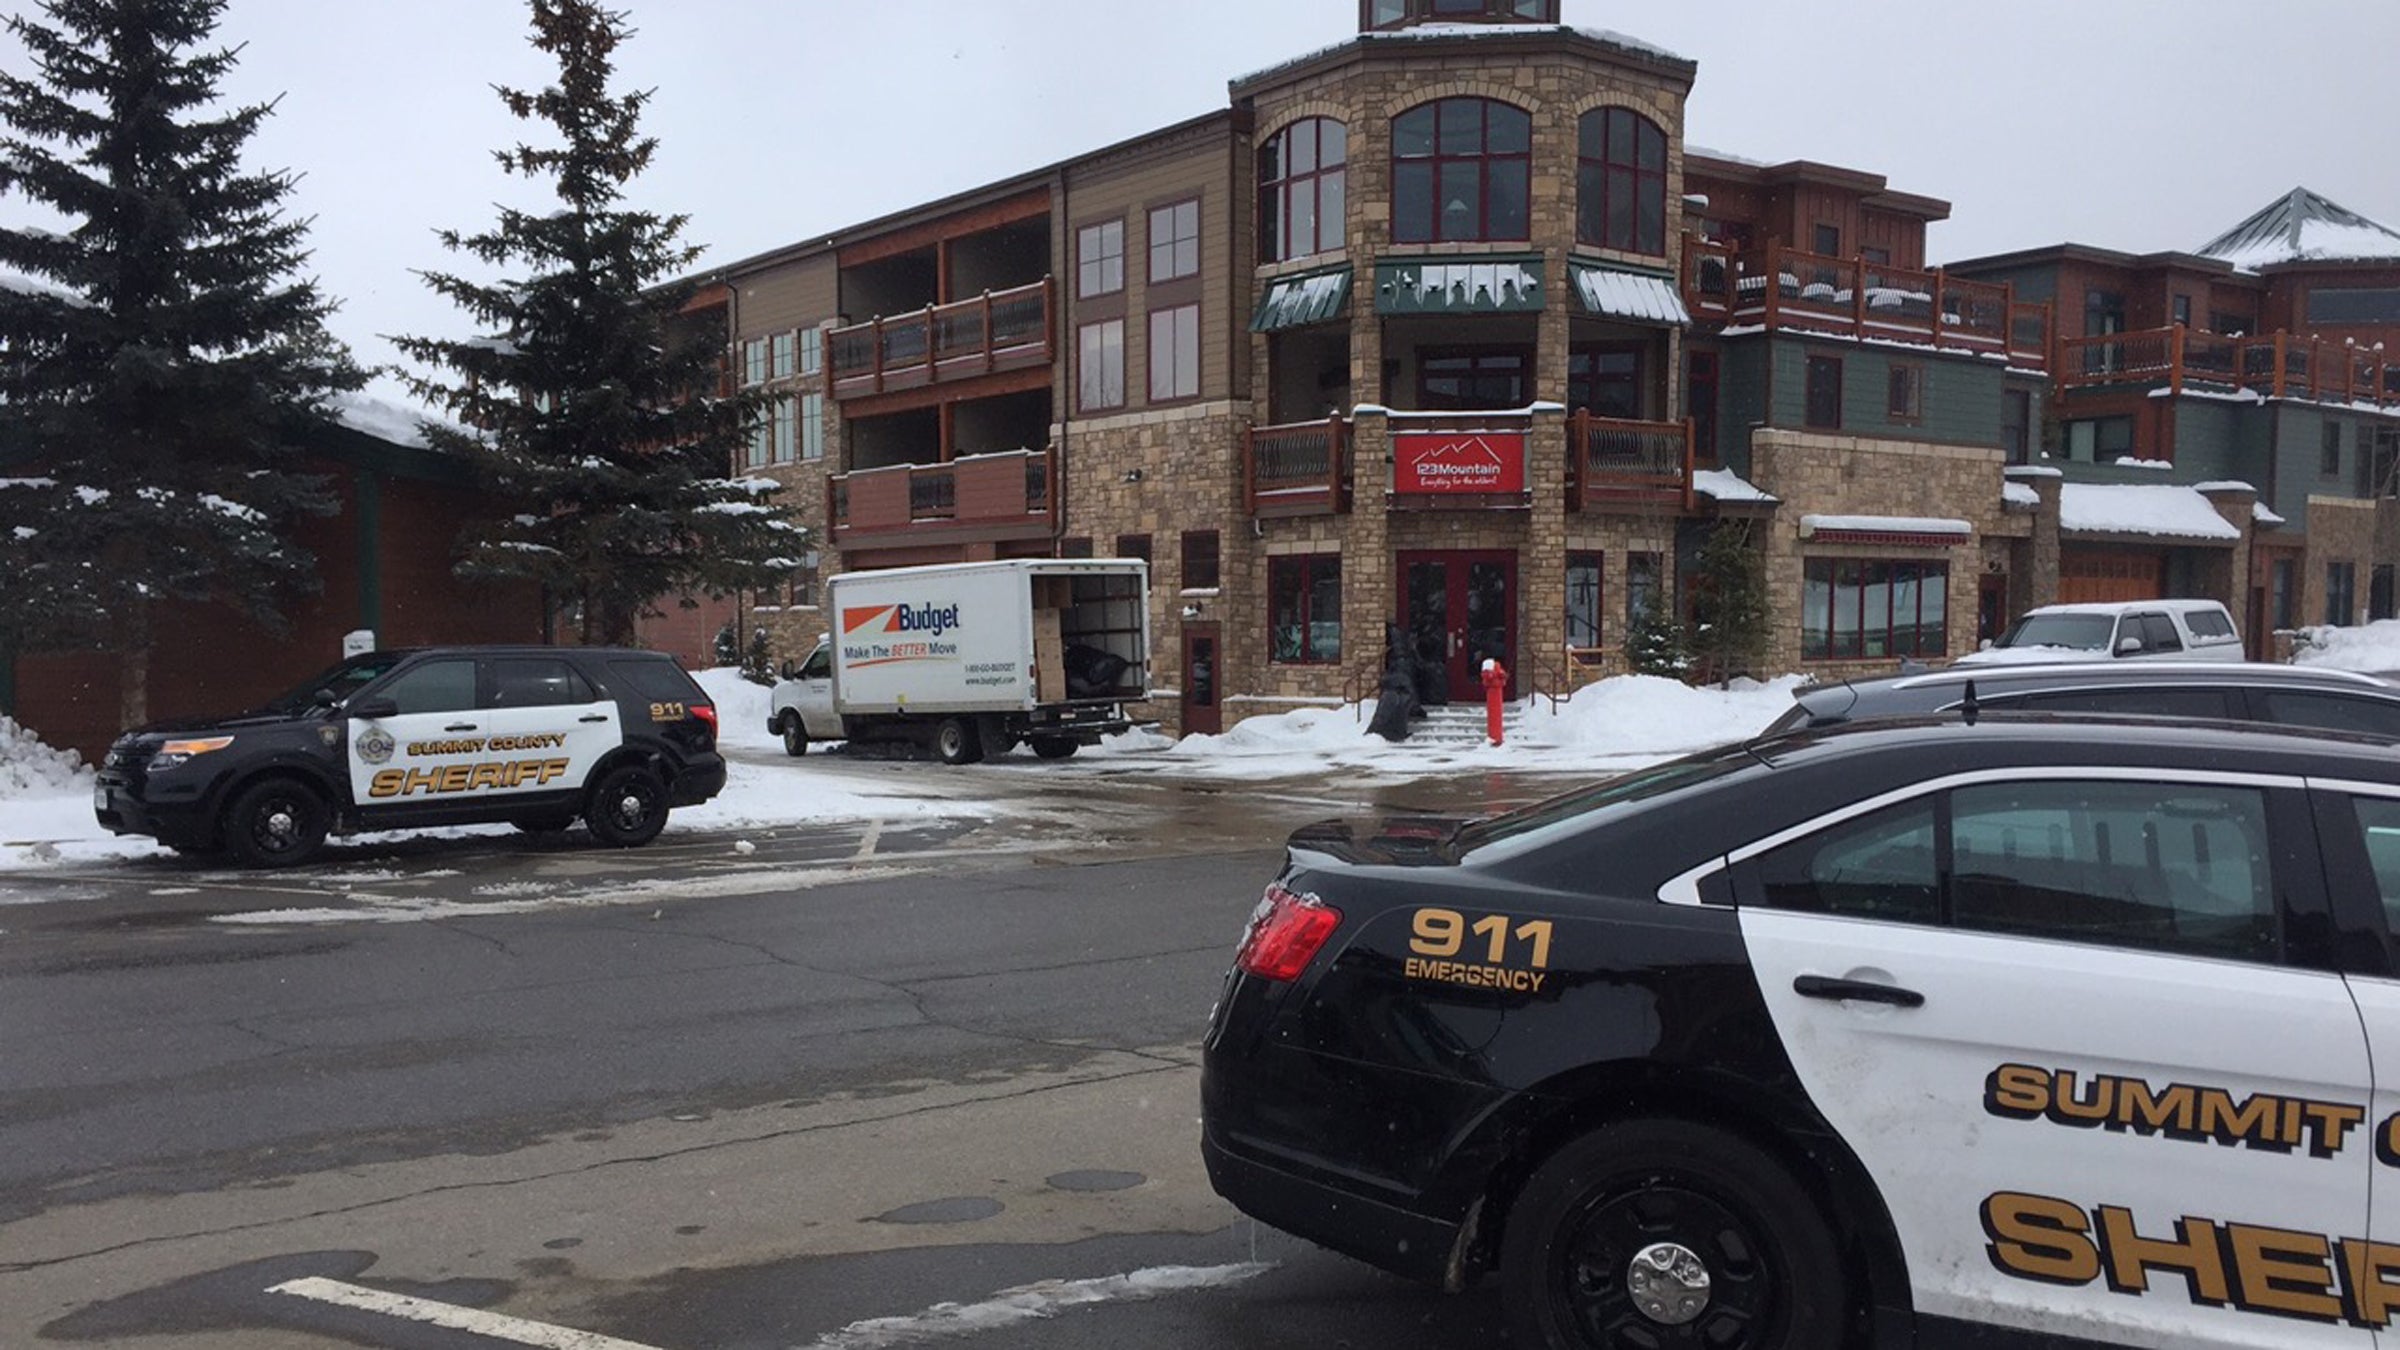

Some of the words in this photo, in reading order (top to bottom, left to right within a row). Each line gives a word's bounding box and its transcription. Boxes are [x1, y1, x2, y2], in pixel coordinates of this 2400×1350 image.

[899, 601, 959, 636] Budget
[844, 646, 870, 659] Make
[872, 644, 889, 657] The
[891, 643, 927, 656] BETTER
[929, 642, 957, 654] Move
[650, 702, 684, 716] 911
[407, 738, 486, 756] SUMMIT
[488, 733, 566, 751] COUNTY
[369, 757, 570, 797] SHERIFF
[1409, 908, 1553, 968] 911
[1404, 957, 1546, 992] EMERGENCY
[1984, 1062, 2365, 1159] SUMMIT
